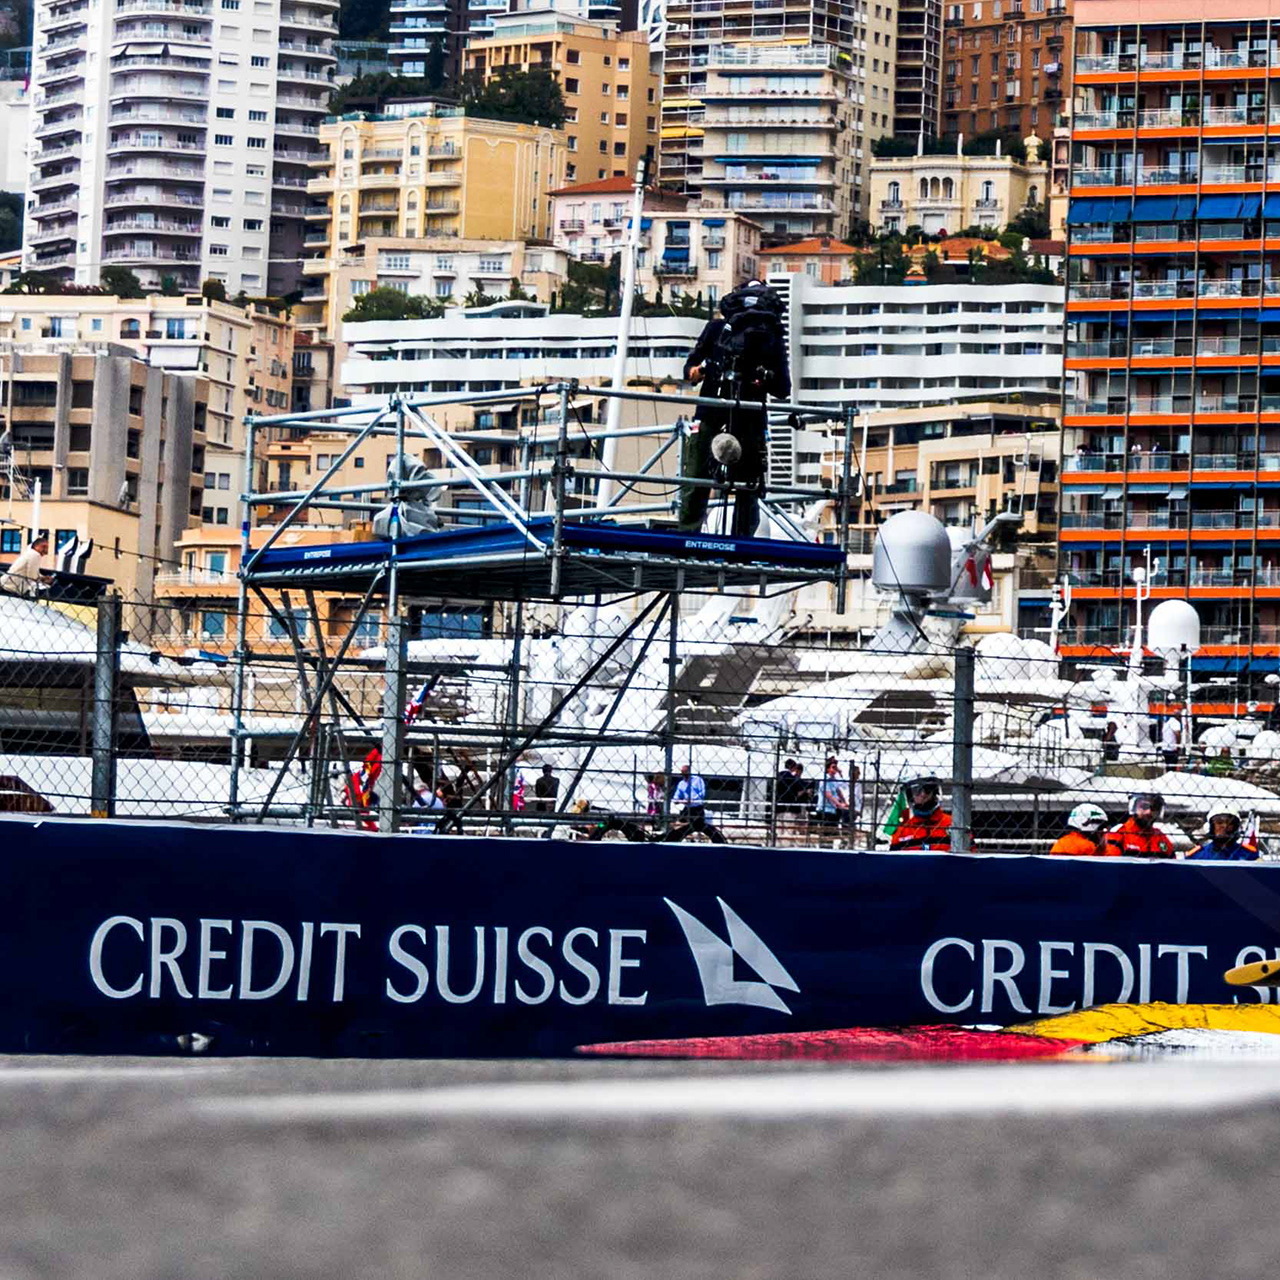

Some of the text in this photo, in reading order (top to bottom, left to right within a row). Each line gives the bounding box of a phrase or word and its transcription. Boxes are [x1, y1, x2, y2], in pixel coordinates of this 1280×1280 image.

[685, 540, 736, 551] ENTREPOSE
[89, 915, 649, 1007] CREDIT SUISSE
[920, 937, 1209, 1015] CREDIT
